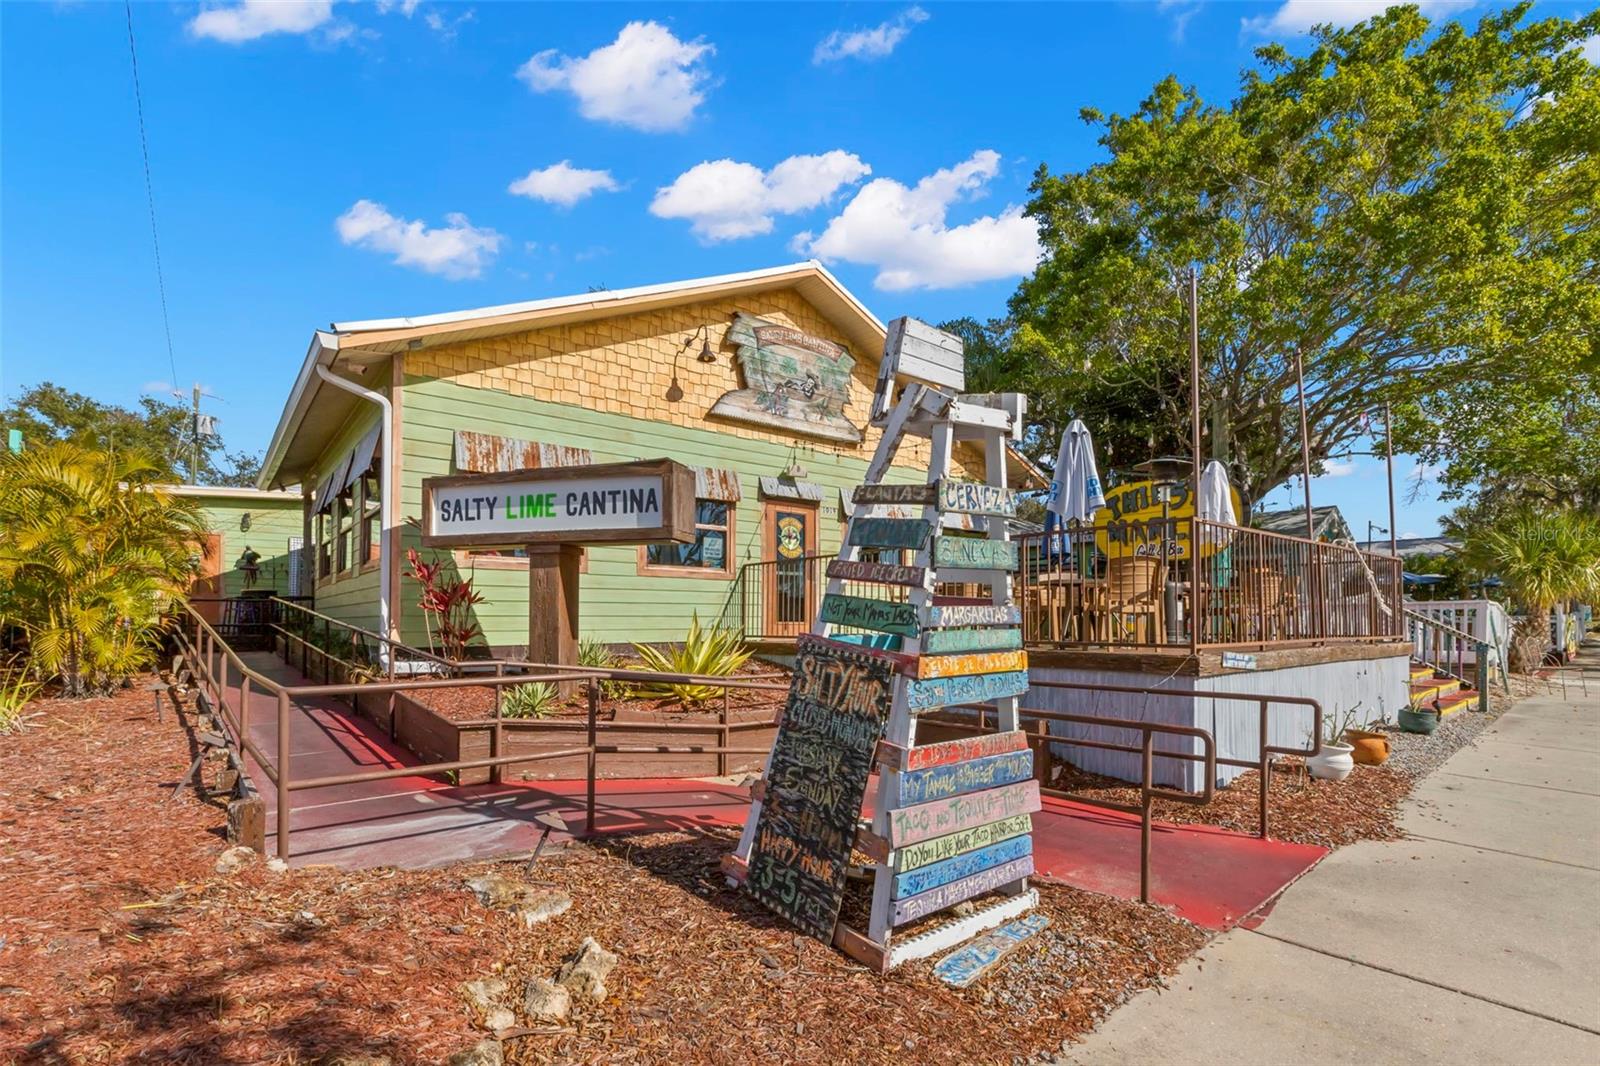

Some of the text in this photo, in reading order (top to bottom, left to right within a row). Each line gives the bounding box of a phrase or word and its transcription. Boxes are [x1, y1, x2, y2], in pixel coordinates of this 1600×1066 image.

[441, 488, 659, 522] SALTY LIME CANTINA
[945, 482, 1016, 517] CERVEZA
[941, 606, 1008, 626] MARGARITAS
[904, 778, 920, 797] MY
[896, 810, 929, 840] TACO
